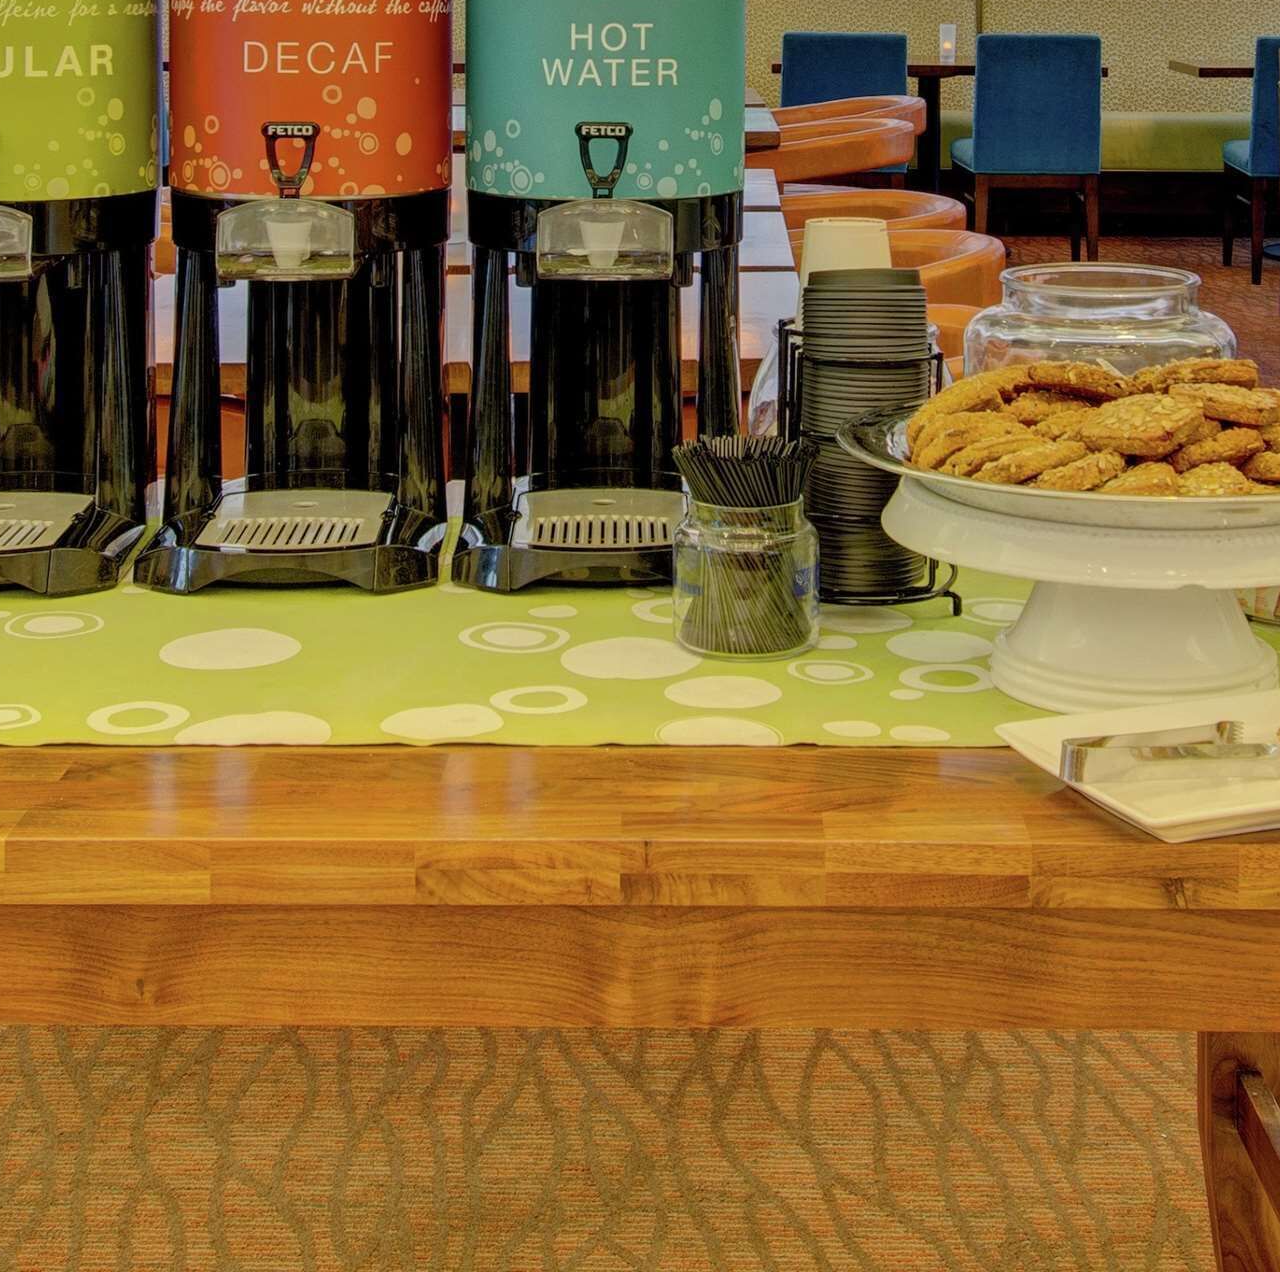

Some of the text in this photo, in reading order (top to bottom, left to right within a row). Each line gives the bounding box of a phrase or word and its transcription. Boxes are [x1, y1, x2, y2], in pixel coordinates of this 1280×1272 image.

[107, 3, 118, 16] a
[570, 23, 654, 52] HOT
[243, 41, 393, 74] DECAF
[542, 58, 679, 87] WATER
[268, 125, 313, 136] FETCO
[581, 125, 626, 136] FETCO
